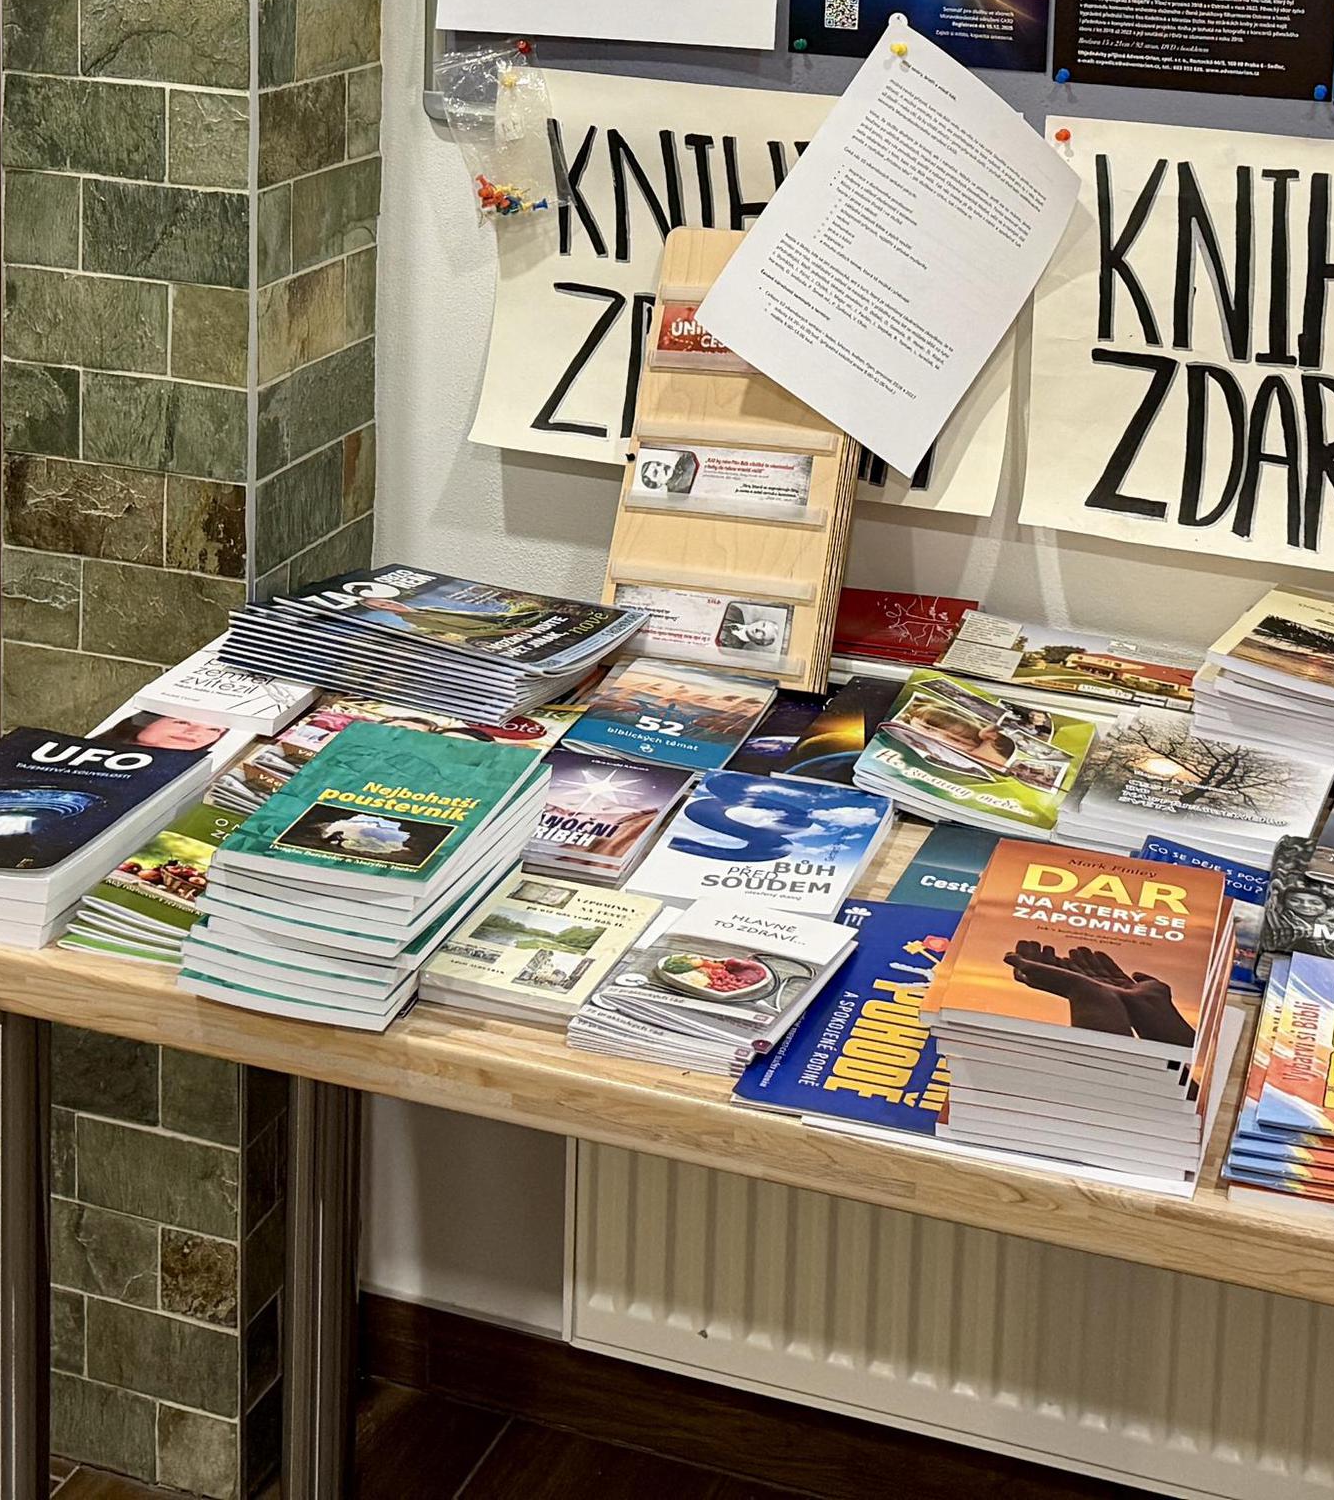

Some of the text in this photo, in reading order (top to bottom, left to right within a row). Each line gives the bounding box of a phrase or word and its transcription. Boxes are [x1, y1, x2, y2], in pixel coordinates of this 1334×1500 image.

[606, 724, 700, 753] biblických témat
[634, 715, 686, 737] 52
[31, 741, 153, 772] UFO
[318, 787, 468, 823] poustevník
[362, 780, 482, 810] Nejbohatší
[727, 865, 778, 880] PŘED
[773, 859, 836, 878] BŮH
[1067, 856, 1158, 879] Mark Finley
[700, 874, 832, 894] SOUDEM
[920, 874, 977, 895] Cesta
[1020, 863, 1189, 915] DAR
[731, 913, 799, 934] HLAVNĚ
[1012, 907, 1186, 942] ZAPOMNĚLO
[1016, 893, 1186, 930] NA KTERÝ SE
[798, 991, 858, 1087] A SPOKOJENÉ RODINĚ
